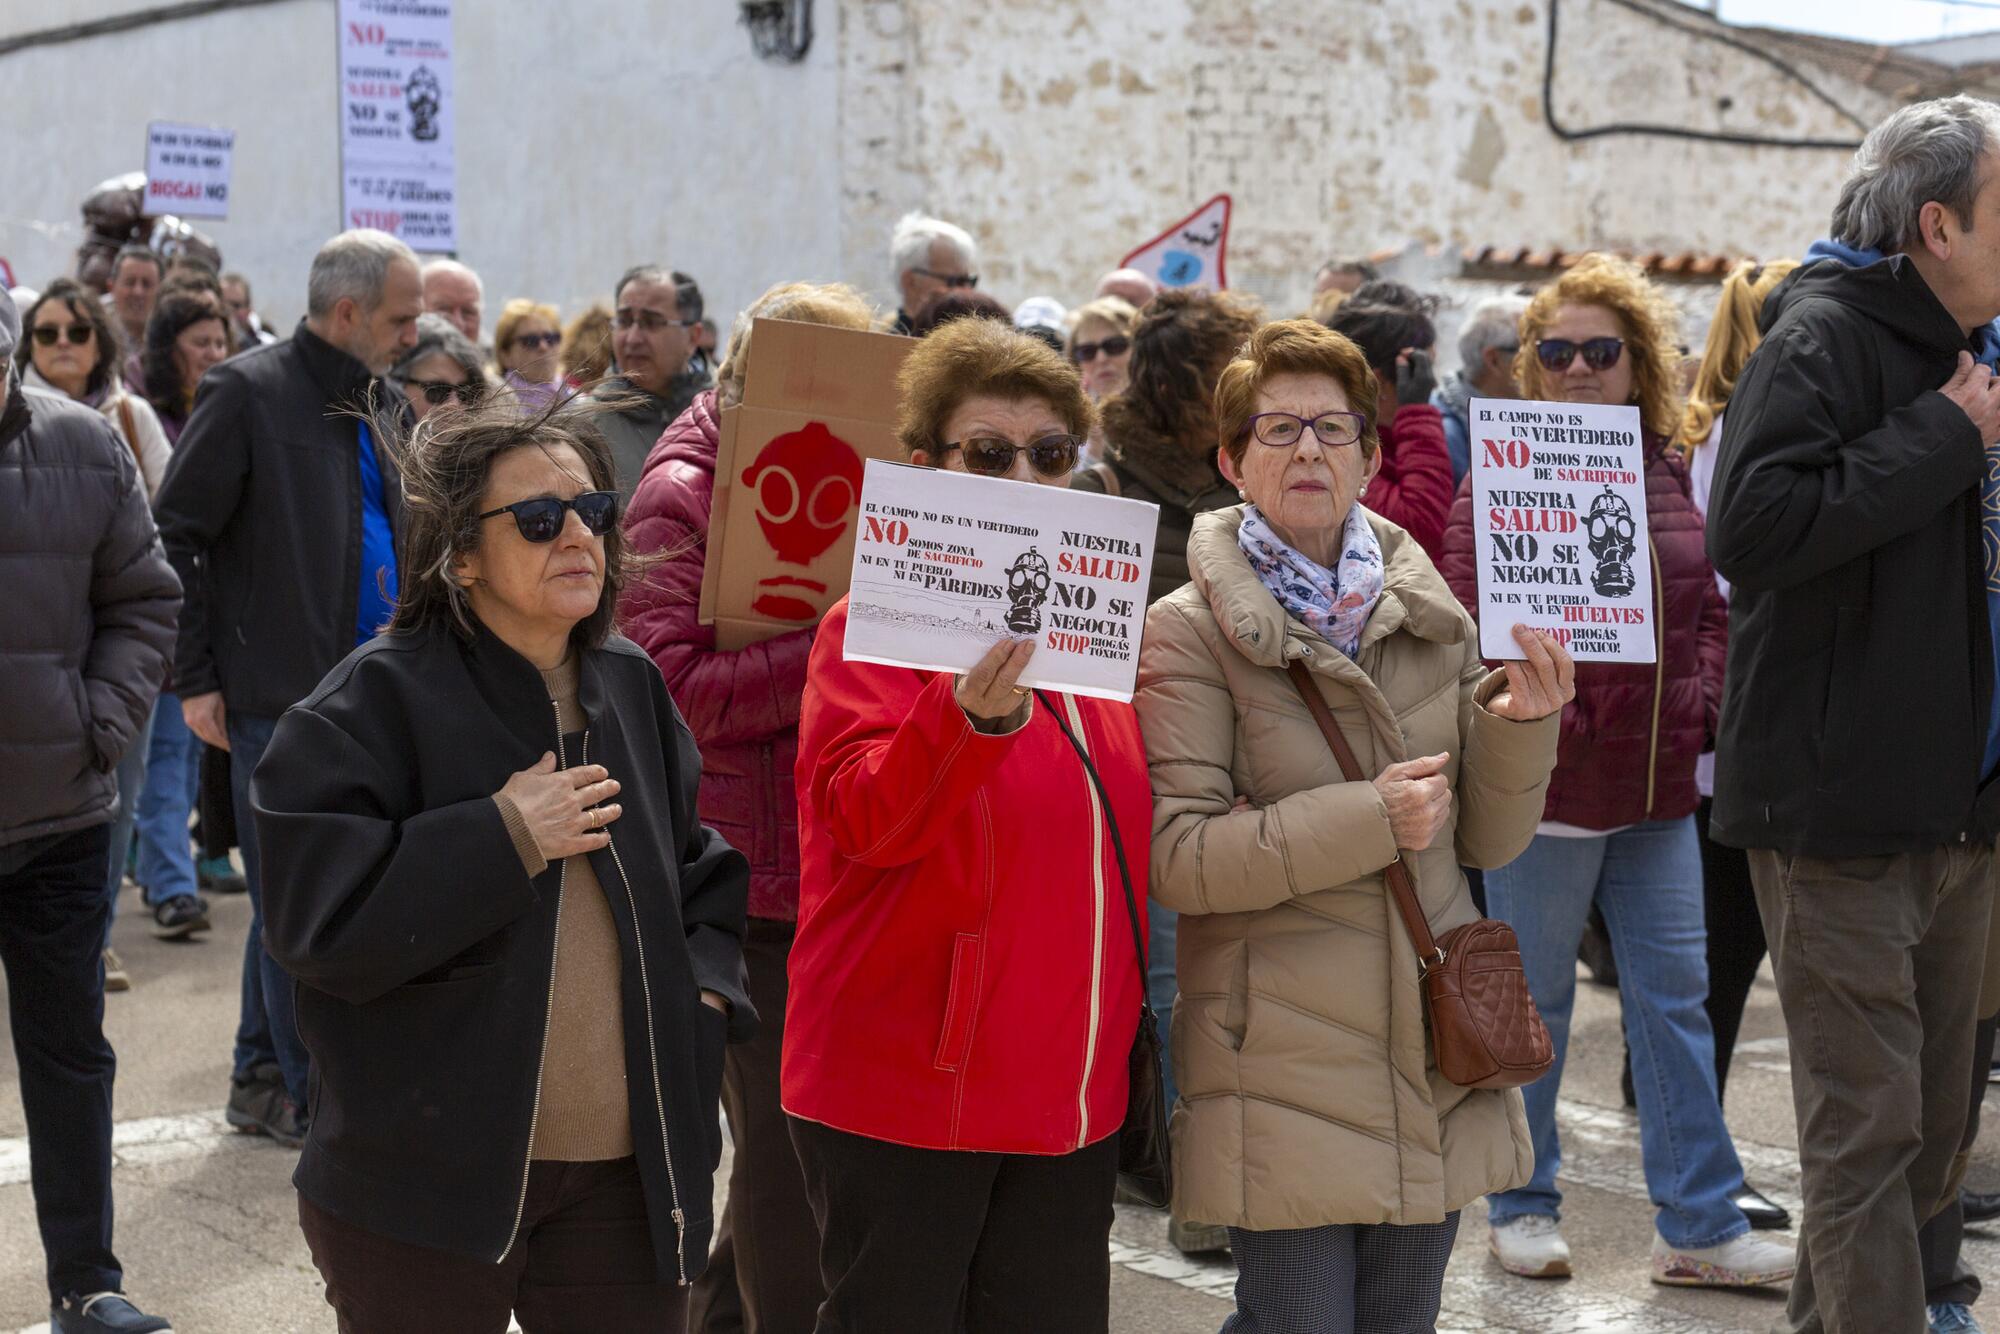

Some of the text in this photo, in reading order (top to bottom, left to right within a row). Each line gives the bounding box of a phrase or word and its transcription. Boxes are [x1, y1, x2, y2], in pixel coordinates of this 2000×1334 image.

[347, 21, 385, 46] NO
[348, 101, 378, 120] NO
[205, 183, 227, 202] NO
[1480, 411, 1582, 425] EL CAMPO NO ES
[1512, 426, 1634, 447] UN VERTEDERO
[1482, 439, 1623, 469] NO SOMOS ZONA
[1534, 468, 1636, 485] DE SACRIFICIO
[1488, 490, 1576, 509] NUESTRA
[866, 503, 1039, 537] EL CAMPO NO ES UN VERTEDERO
[1490, 508, 1577, 533] SALUD
[863, 516, 975, 556] NO SOMOS ZONA
[1060, 531, 1141, 557] NUESTRA
[907, 549, 983, 569] DE SACRIFICIO
[1490, 534, 1579, 564] NO SE
[860, 554, 953, 577] NI EN TU PUEBLO
[1057, 552, 1139, 583] SALUD
[1493, 566, 1582, 585] NEGOCIA
[894, 570, 1003, 599] NI EN PAREDES
[1052, 582, 1133, 617] NO SE
[1490, 593, 1589, 605] NI EN TU PUEBLO
[1532, 605, 1644, 624] NI EN HUELVES
[1049, 613, 1128, 638] NEGOCIA
[1572, 627, 1617, 640] BIOGÁS
[1047, 631, 1090, 654] STOP
[1091, 637, 1129, 650] BIOGÁS
[1572, 641, 1620, 653] TÓXICO!
[1089, 646, 1130, 661] TÓXICO!
